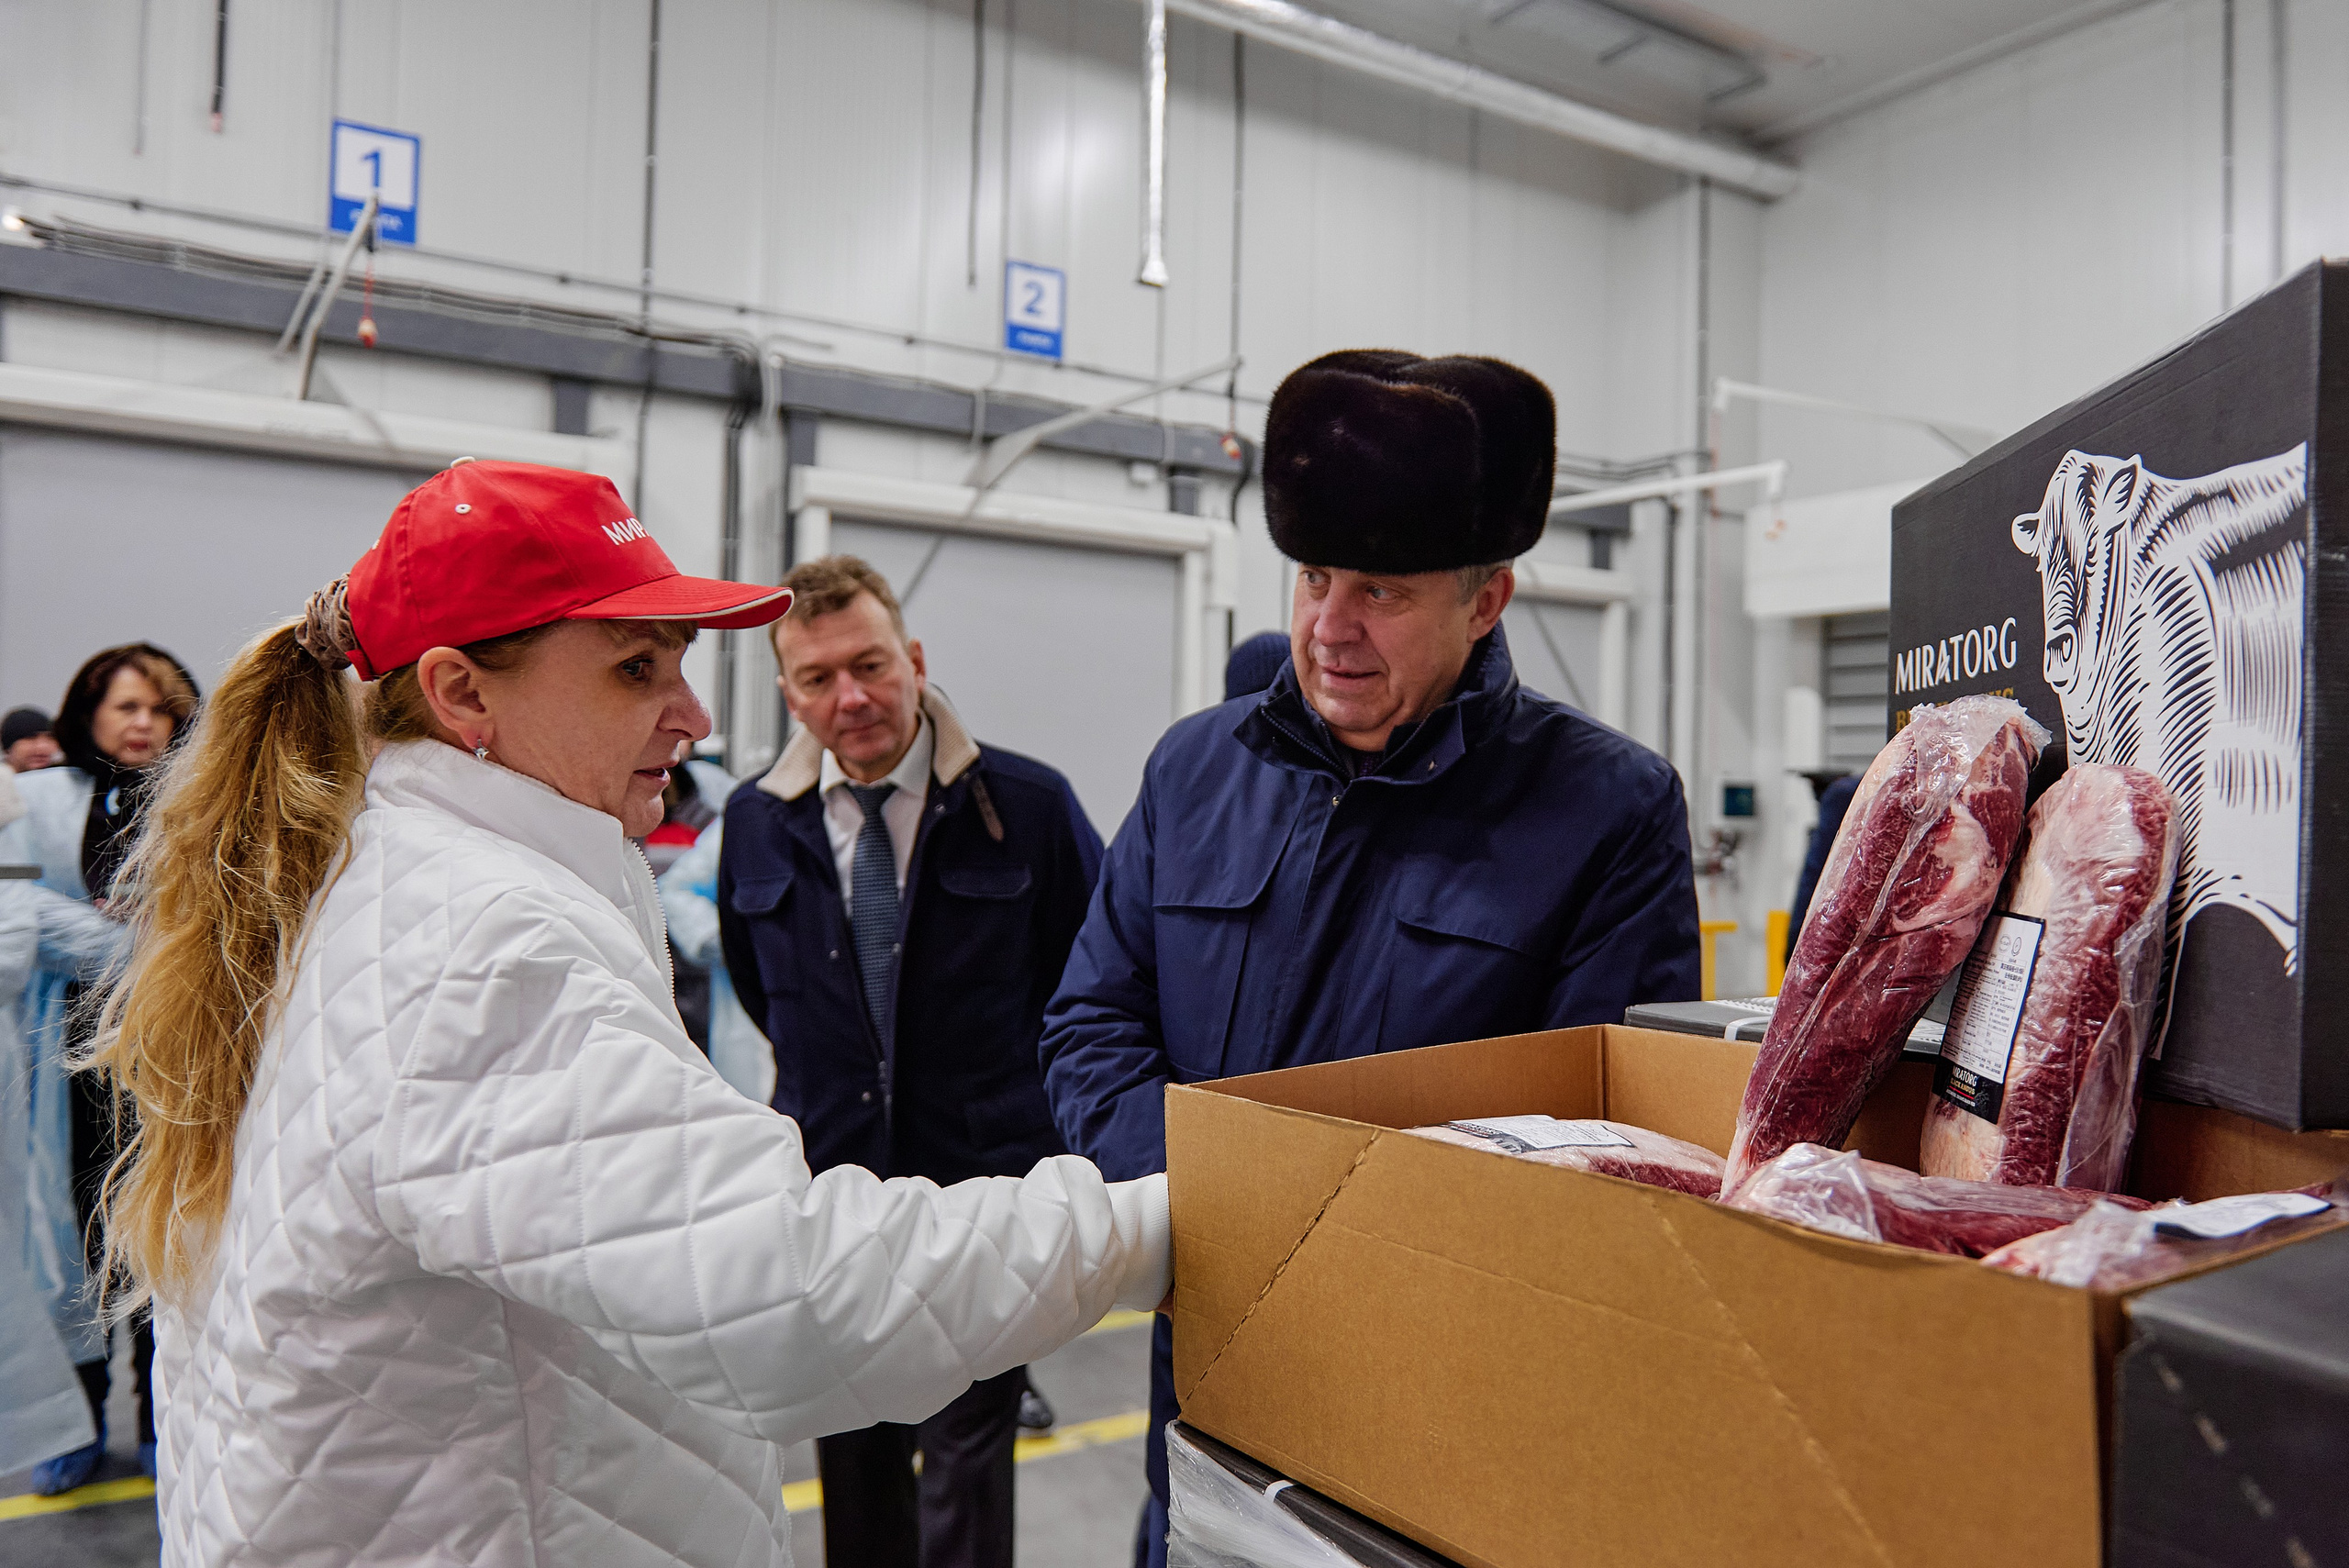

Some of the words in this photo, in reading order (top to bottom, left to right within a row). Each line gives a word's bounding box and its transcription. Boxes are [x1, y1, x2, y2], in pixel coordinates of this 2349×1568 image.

[362, 150, 381, 188] 1
[1023, 281, 1044, 315] 2
[1895, 617, 2017, 695] MIRATORG
